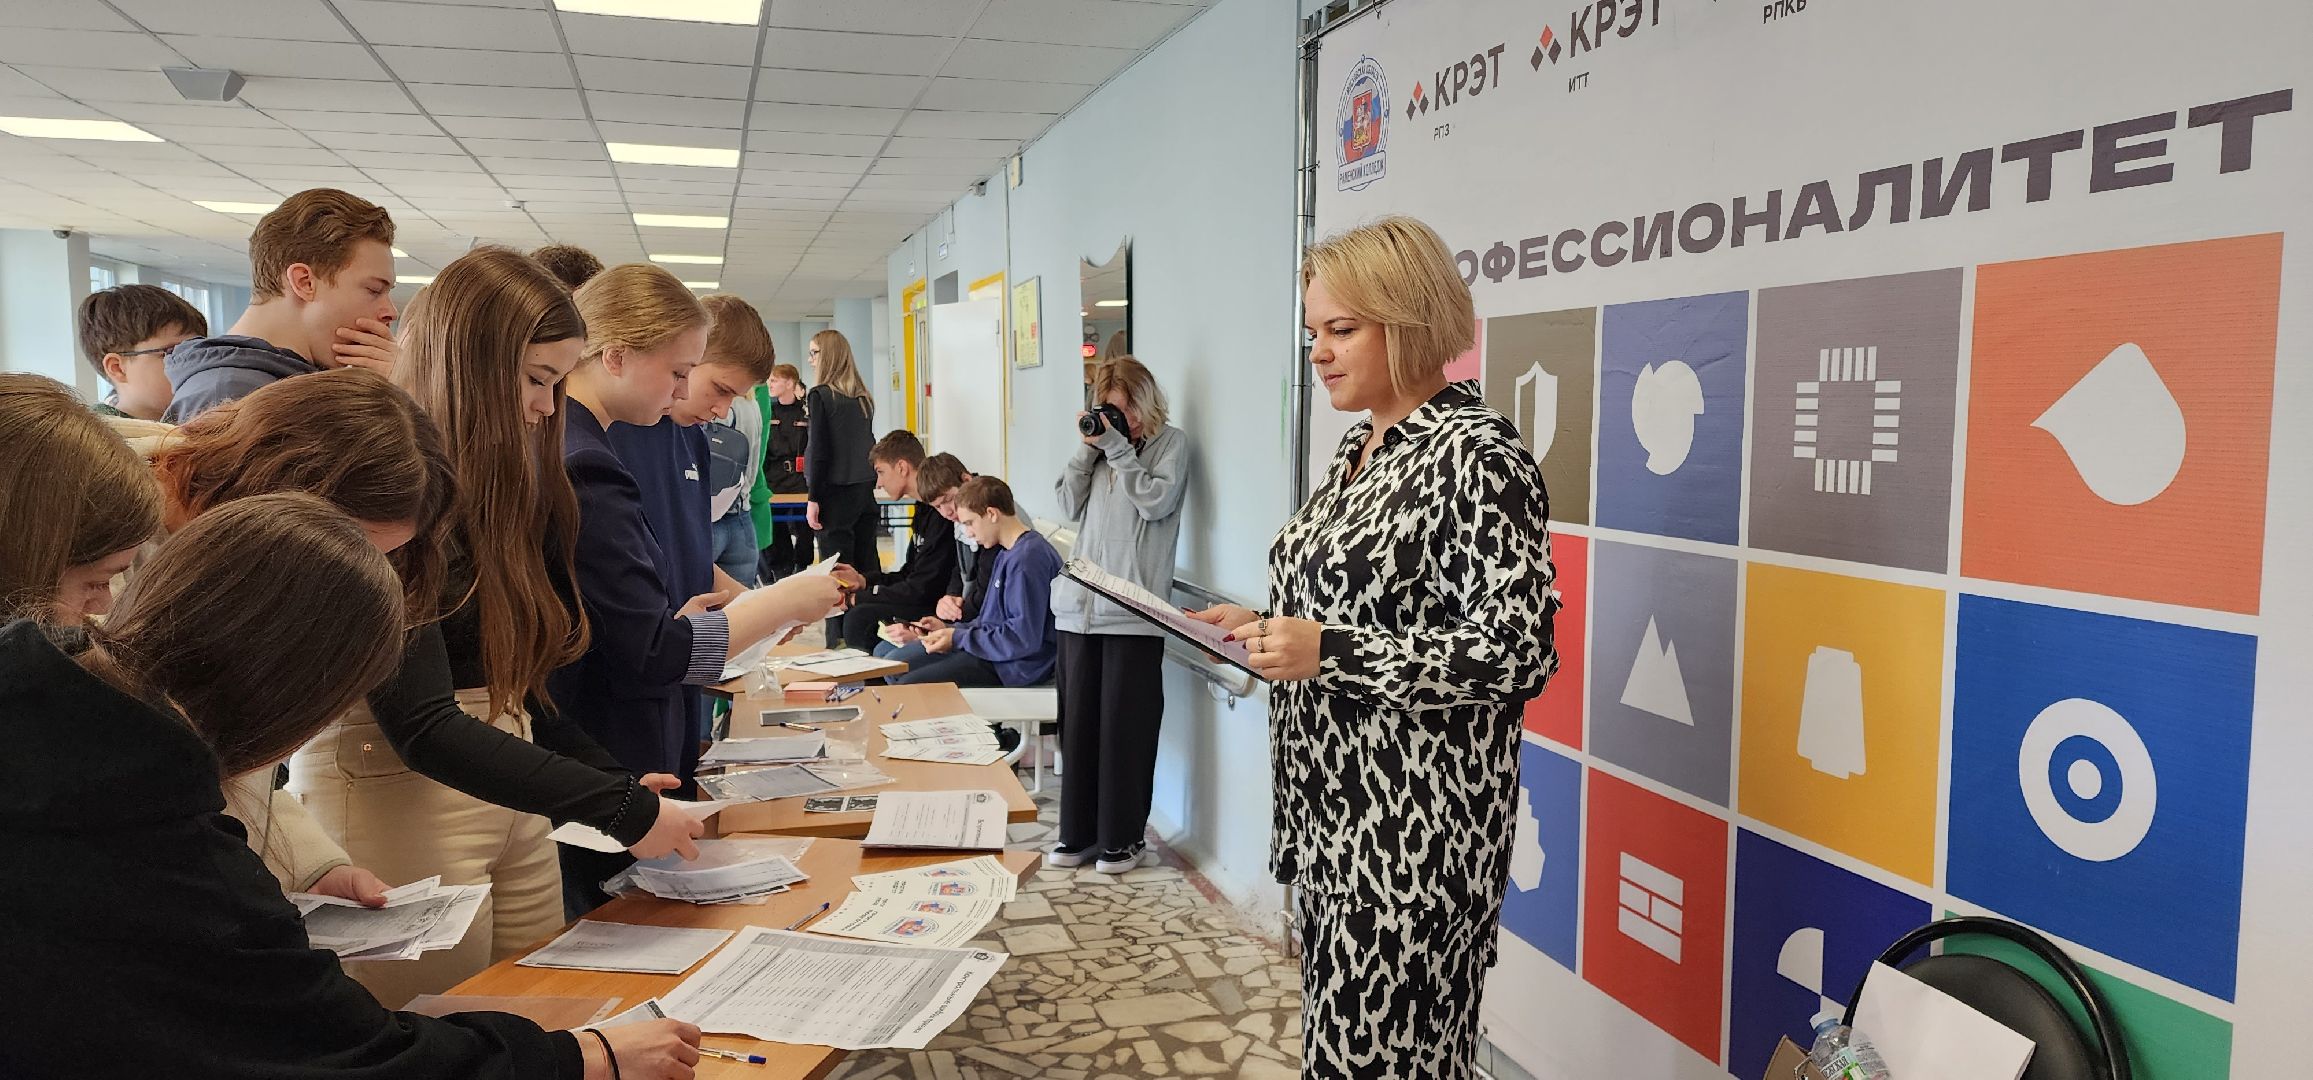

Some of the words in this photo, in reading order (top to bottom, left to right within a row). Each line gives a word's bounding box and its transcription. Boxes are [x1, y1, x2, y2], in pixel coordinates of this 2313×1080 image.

[1434, 42, 1505, 112] КРЭТ
[1568, 71, 1590, 94] ИТТ
[1433, 123, 1450, 141] РПЗ
[1454, 88, 2294, 287] ОФЕССИОНАЛИТЕТ
